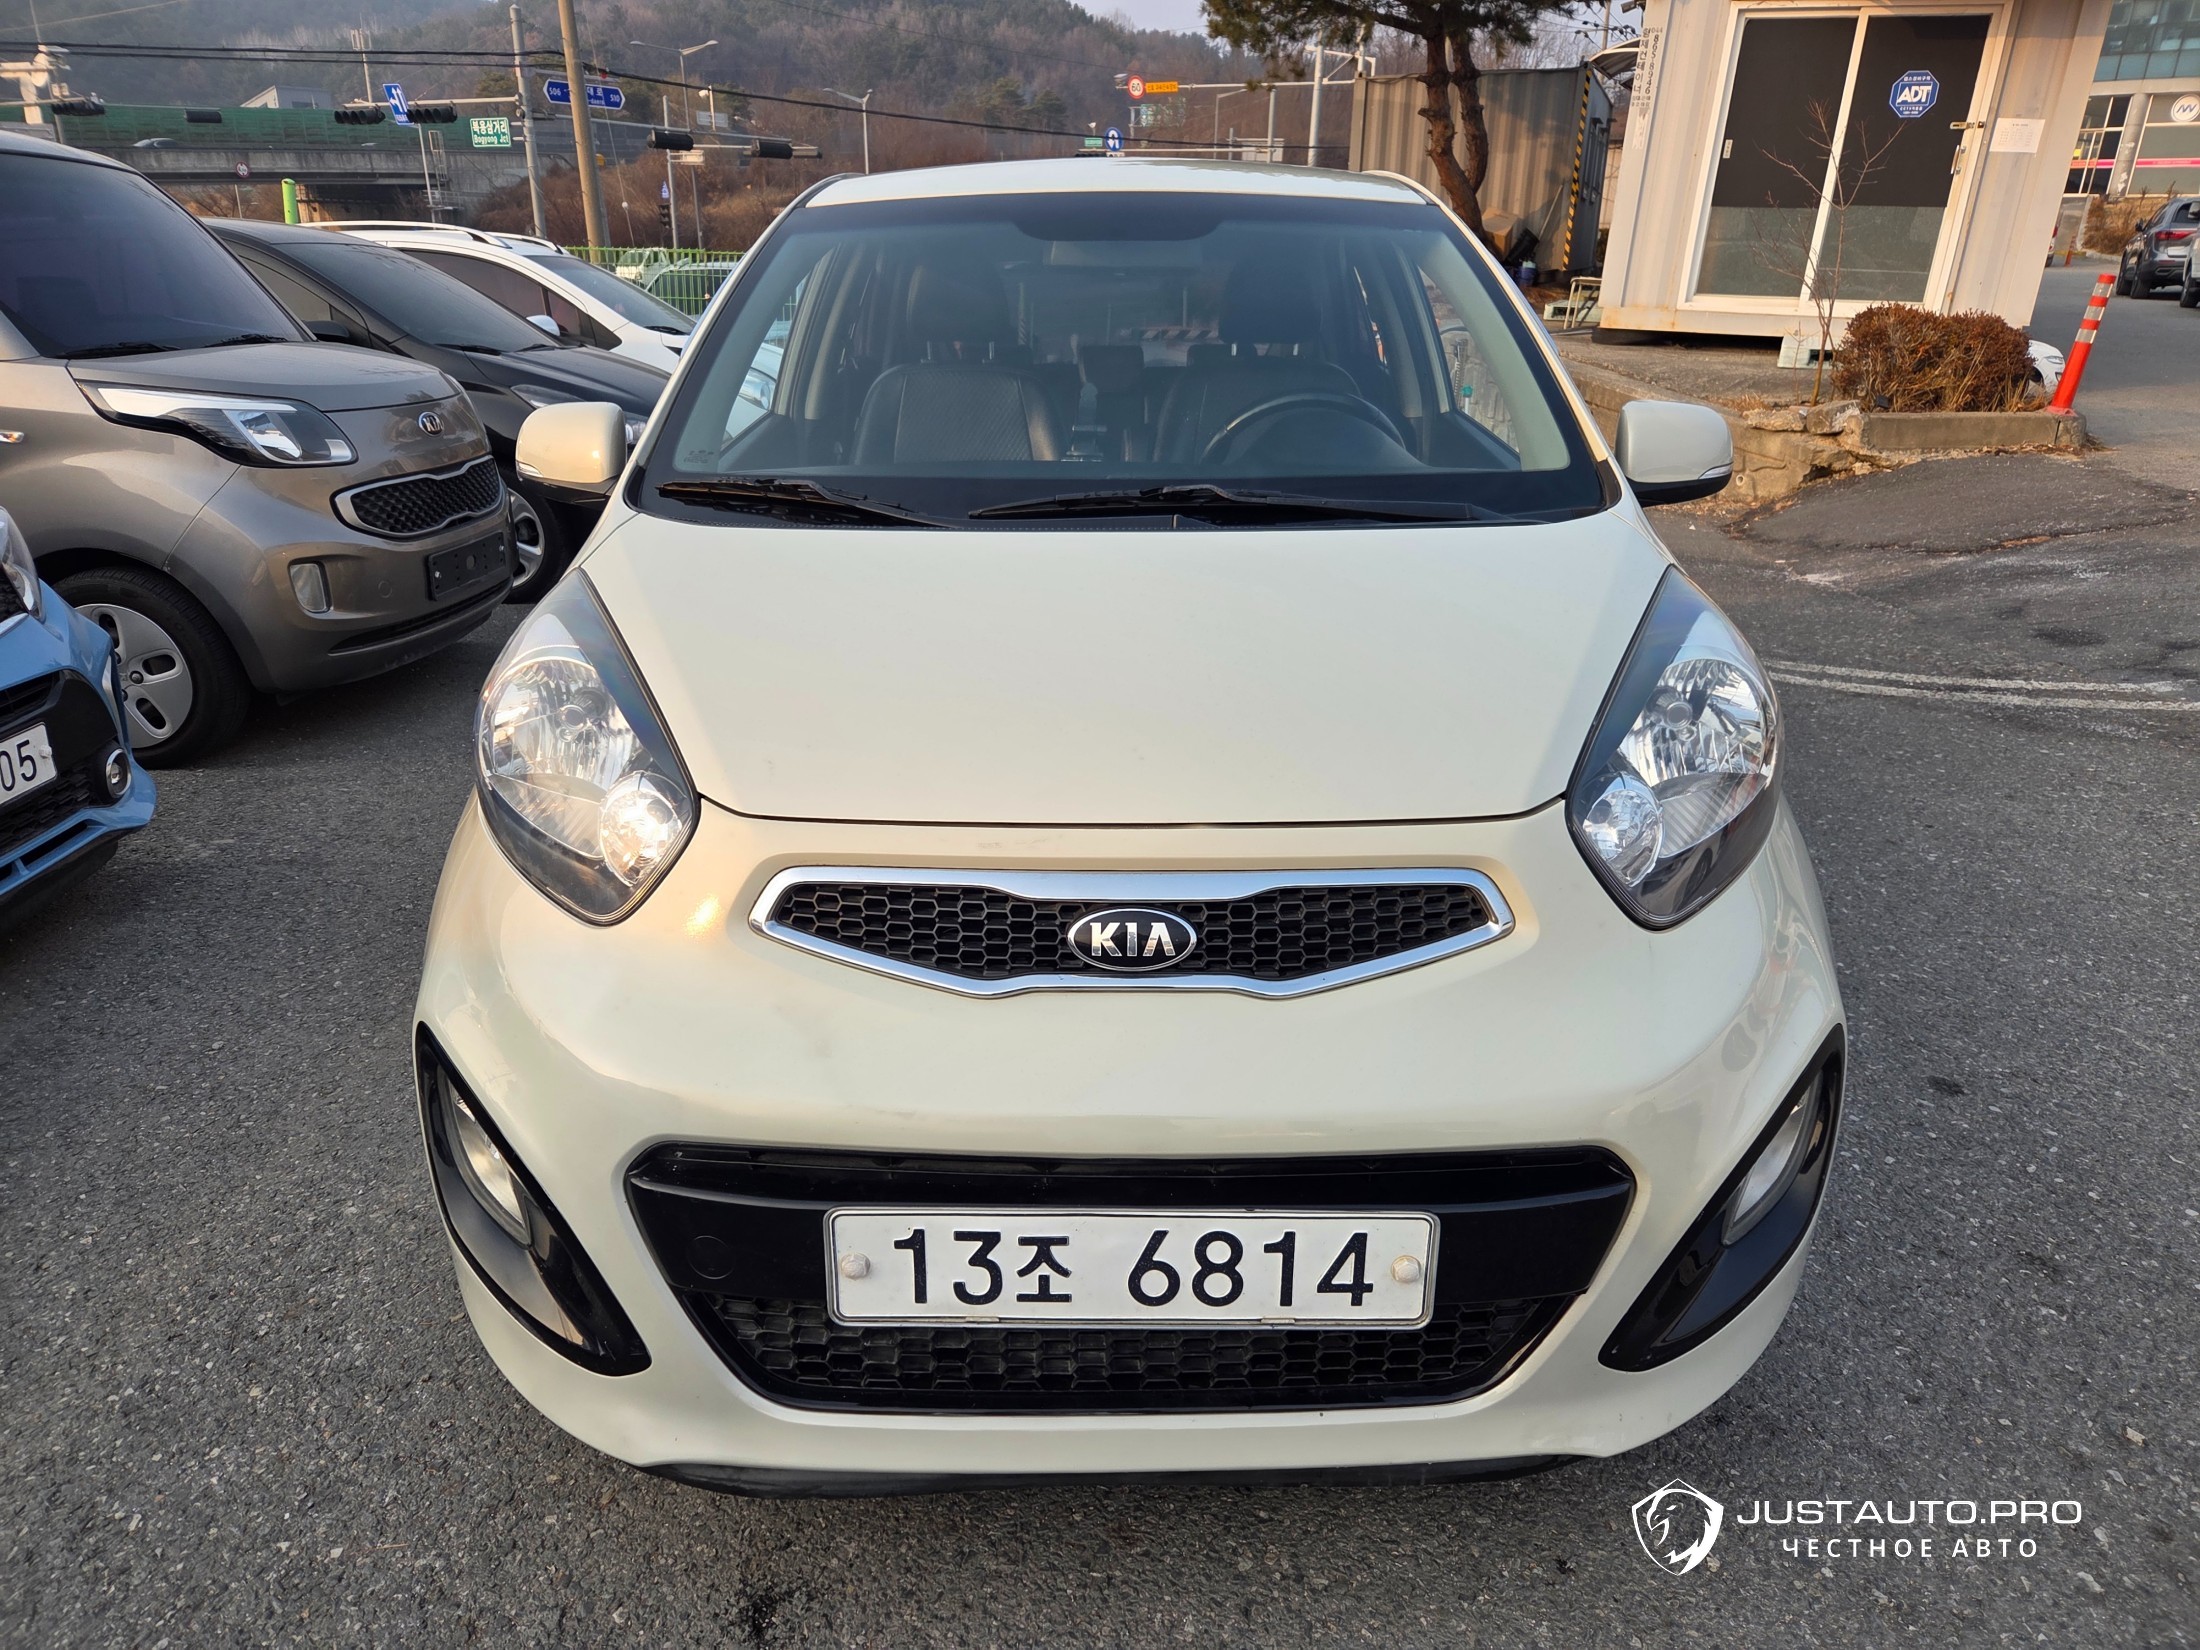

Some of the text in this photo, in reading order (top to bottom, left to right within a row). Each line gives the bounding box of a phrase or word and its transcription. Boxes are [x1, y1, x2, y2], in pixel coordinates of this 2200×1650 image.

[549, 87, 562, 96] 506
[1897, 86, 1932, 103] ADT
[1089, 922, 1176, 956] KIA
[893, 1228, 1375, 1307] 13조 6814
